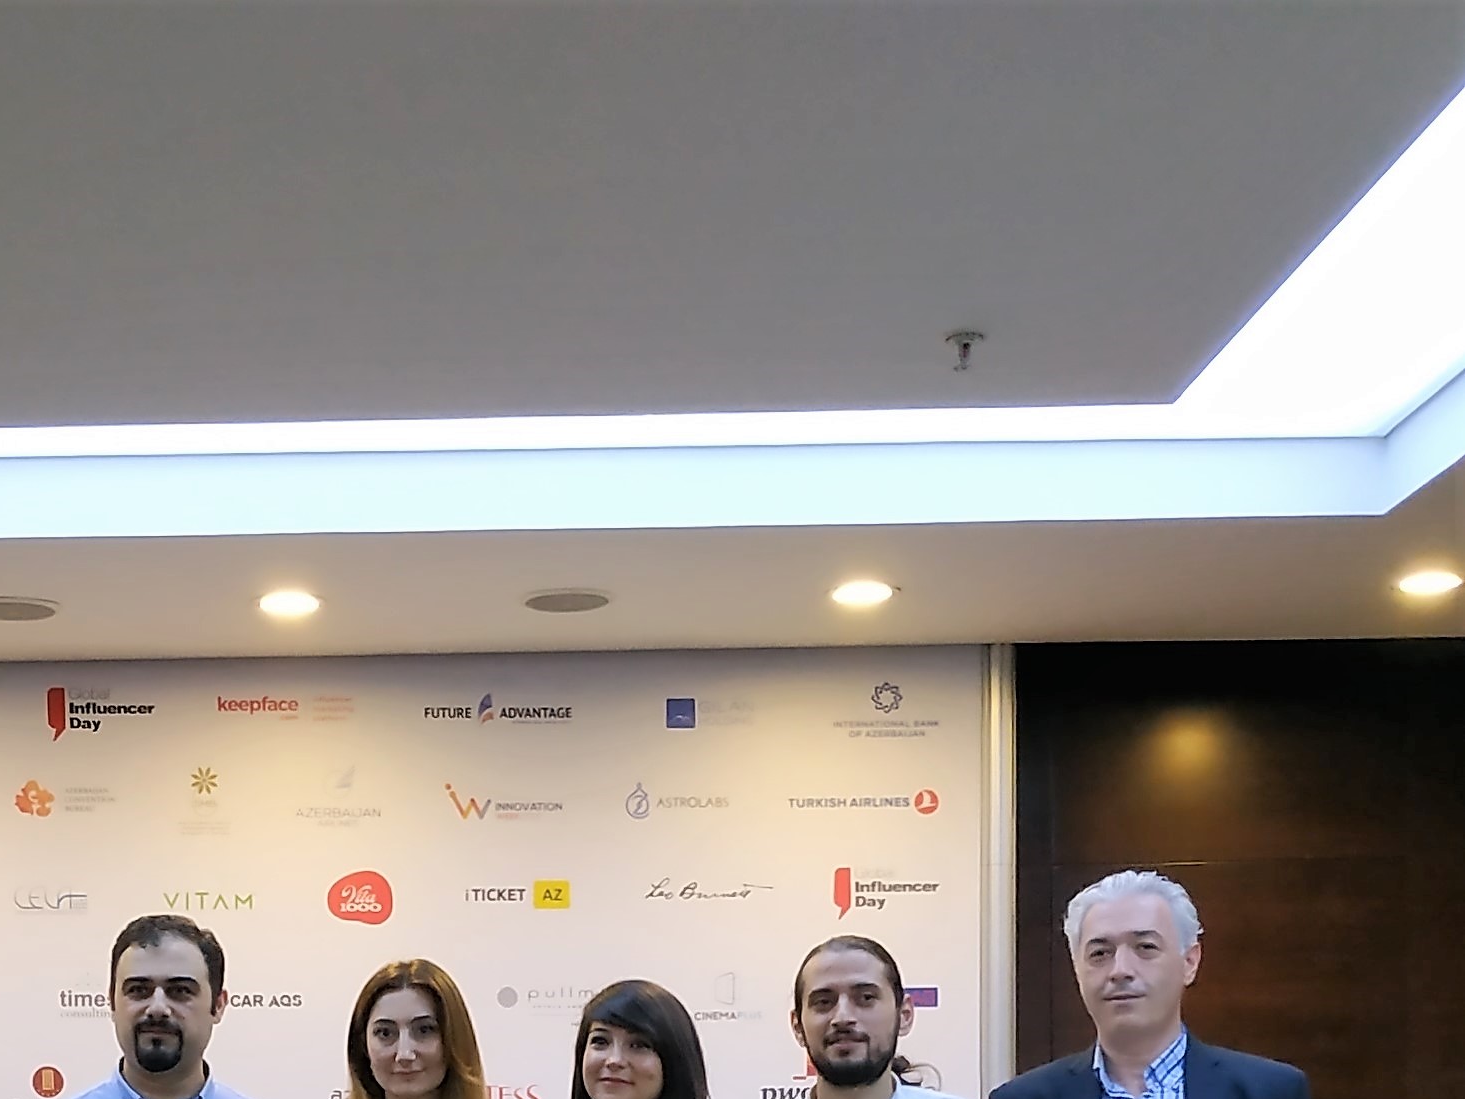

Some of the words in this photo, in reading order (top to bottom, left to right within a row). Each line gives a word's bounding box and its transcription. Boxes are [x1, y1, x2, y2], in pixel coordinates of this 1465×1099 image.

[68, 687, 111, 700] Global
[68, 702, 156, 715] Influencer
[217, 695, 299, 715] keepface
[423, 706, 472, 719] FUTURE
[498, 706, 573, 719] ADVANTAGE
[68, 717, 102, 732] Day
[833, 720, 910, 728] INTERNATIONAL
[912, 720, 940, 728] BANK
[848, 730, 862, 738] OF
[494, 801, 564, 812] INNOVATION
[656, 796, 730, 809] ASTROLABS
[787, 798, 847, 808] TURKISH
[849, 797, 911, 808] AIRLINES
[295, 807, 382, 819] AZERBAIJAN
[854, 881, 940, 893] Influencer
[162, 891, 254, 910] VITAM
[542, 888, 563, 901] AZ
[339, 902, 383, 913] 1000
[854, 895, 886, 910] Day
[230, 994, 264, 1007] CAR
[268, 994, 302, 1007] AQS
